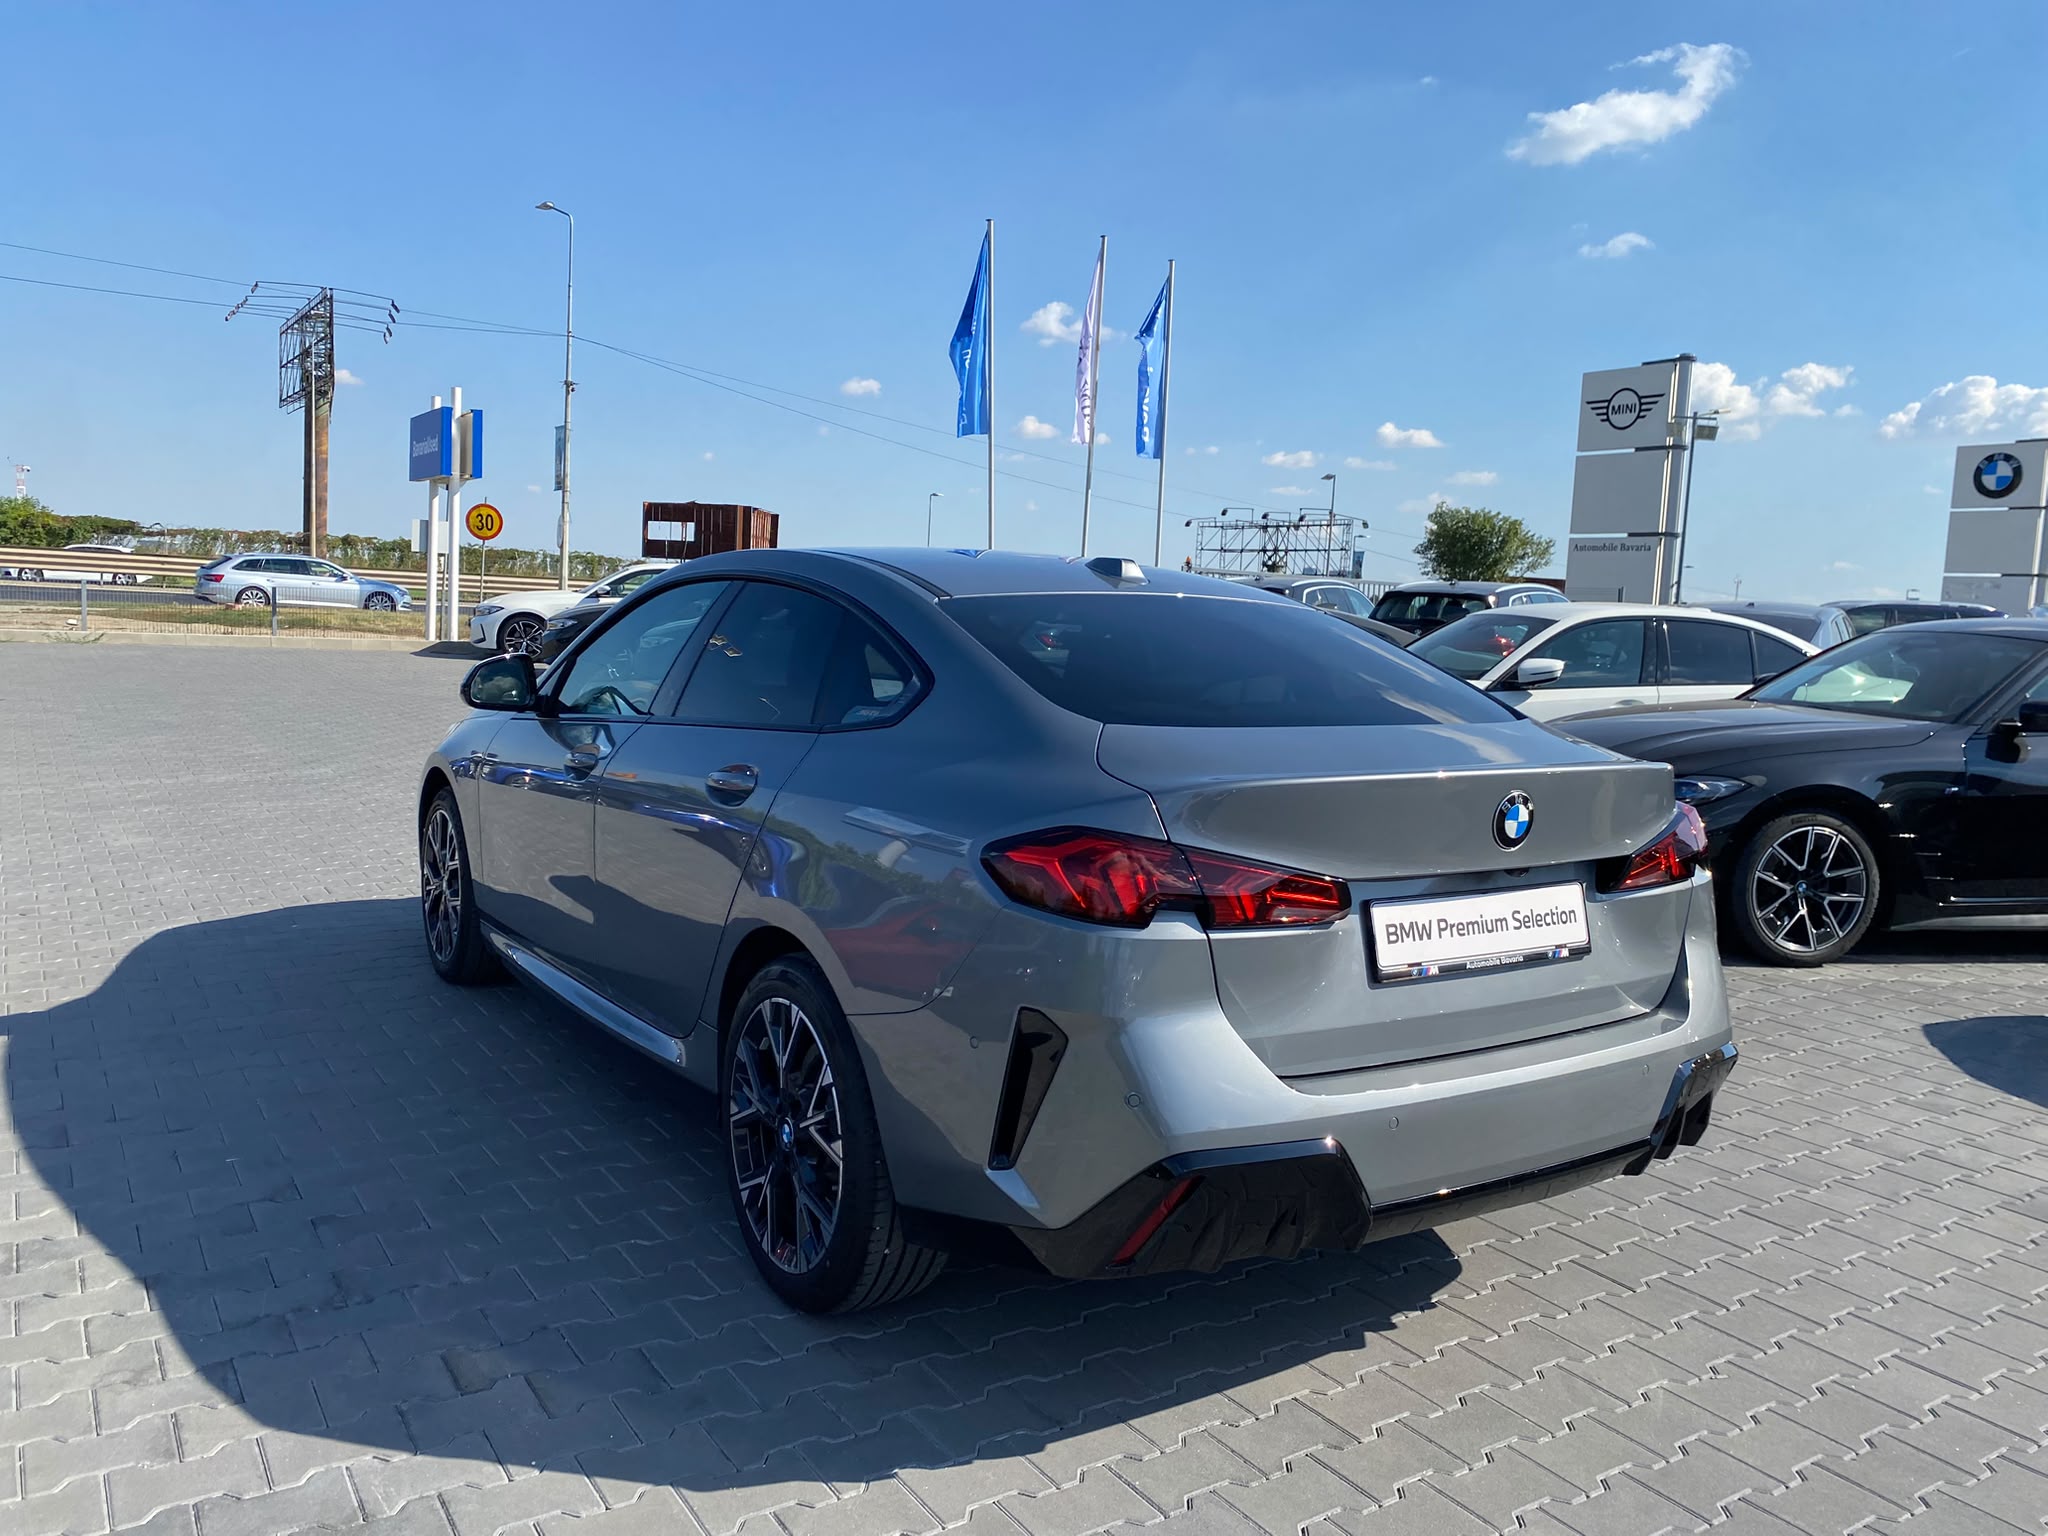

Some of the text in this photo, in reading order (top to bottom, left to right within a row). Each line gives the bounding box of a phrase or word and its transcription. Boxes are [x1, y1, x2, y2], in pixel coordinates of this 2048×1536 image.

[1611, 403, 1637, 415] MINI
[476, 513, 494, 531] 30
[1573, 543, 1651, 552] Automobile Bavaria
[1385, 906, 1577, 945] BMW Premium Selection
[1466, 954, 1524, 969] Automobile Bavaria
